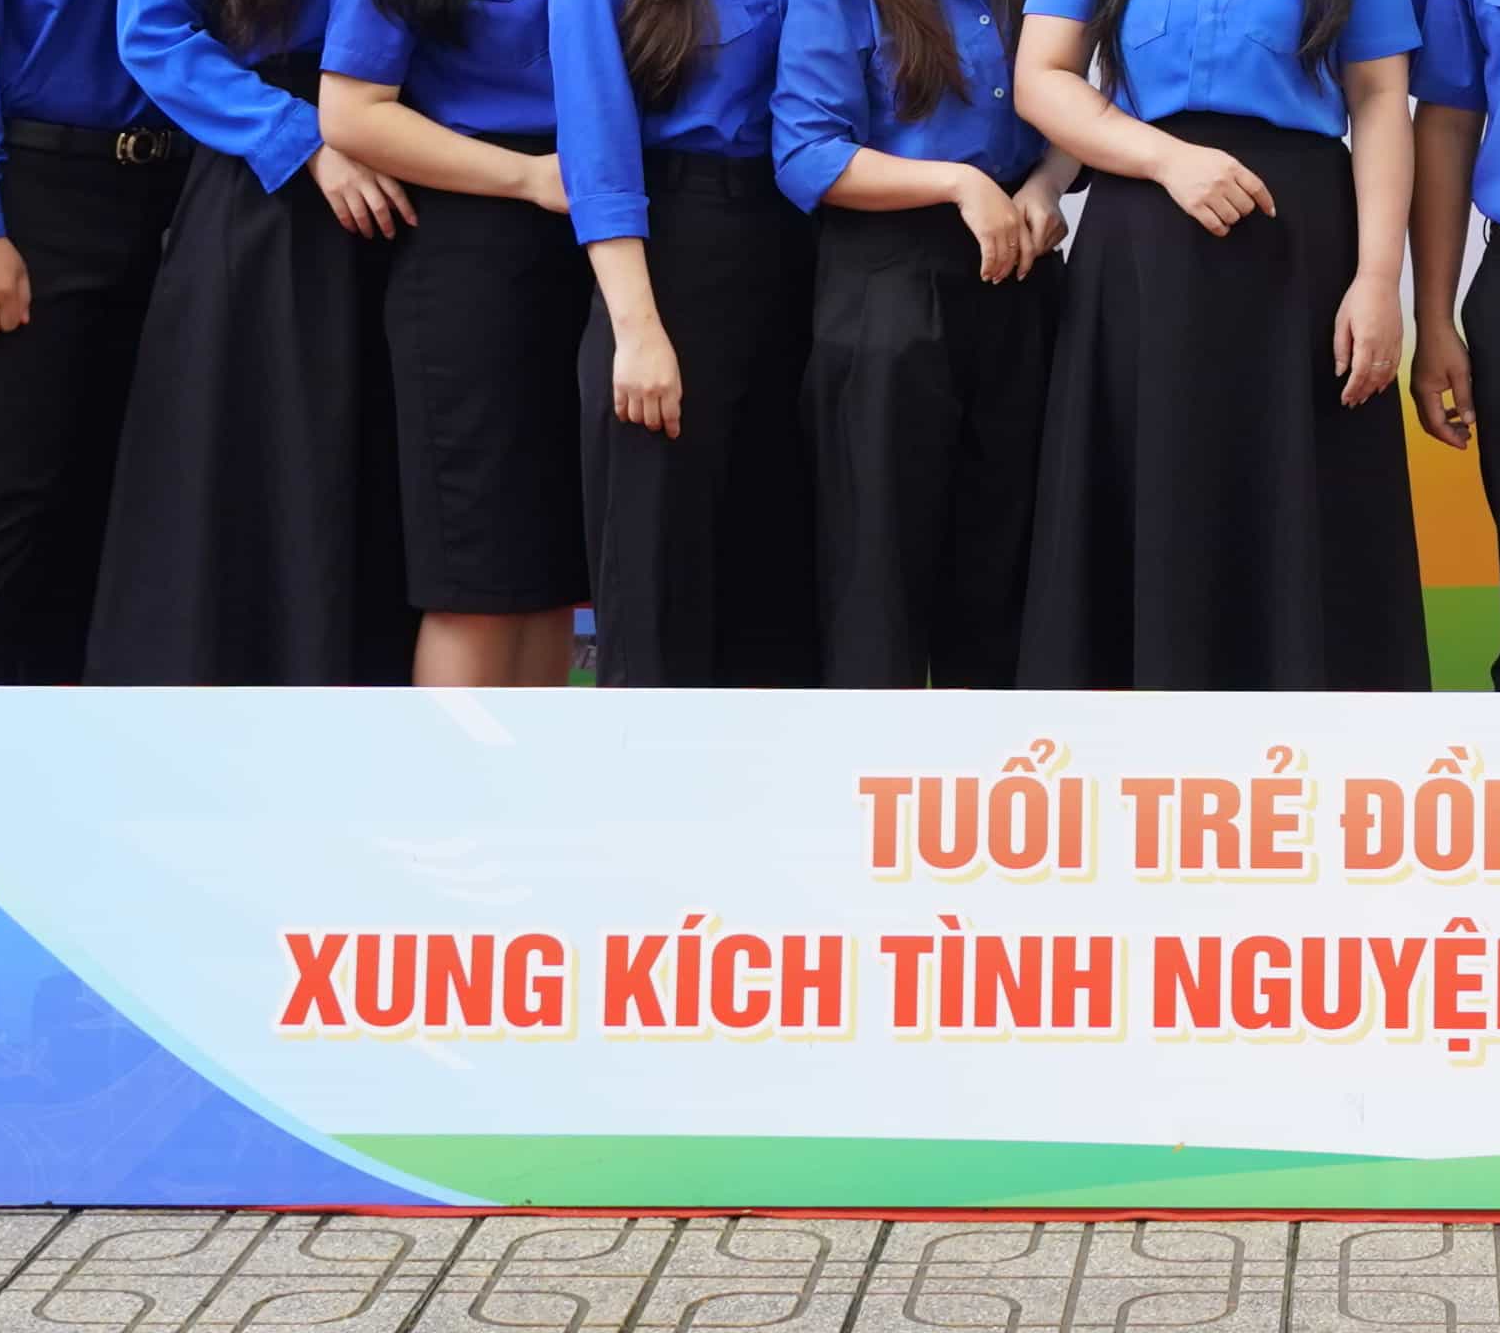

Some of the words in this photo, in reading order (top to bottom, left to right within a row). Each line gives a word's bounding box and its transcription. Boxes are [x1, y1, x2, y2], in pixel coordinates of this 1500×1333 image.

[860, 739, 1082, 869] TUỔI
[1122, 746, 1303, 869] TRẺ
[281, 934, 564, 1027] XUNG
[604, 915, 841, 1028] KÍCH
[881, 915, 1113, 1027] TÌNH
